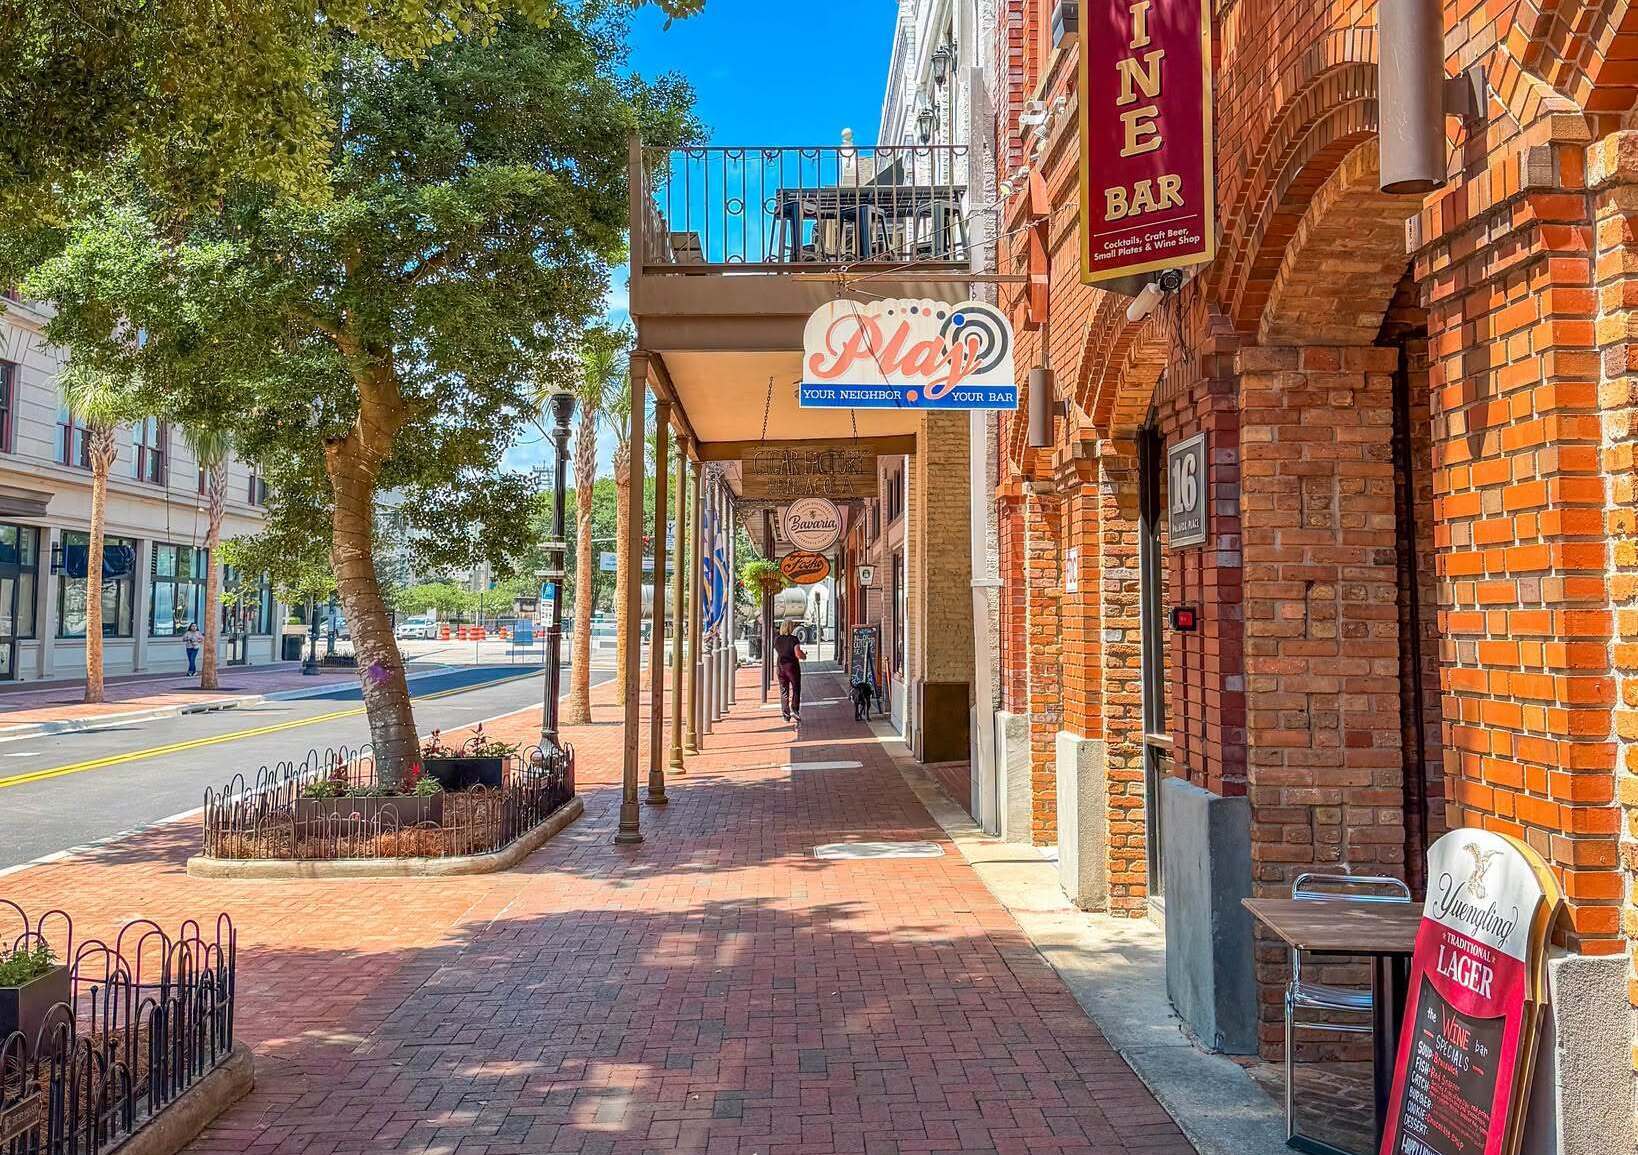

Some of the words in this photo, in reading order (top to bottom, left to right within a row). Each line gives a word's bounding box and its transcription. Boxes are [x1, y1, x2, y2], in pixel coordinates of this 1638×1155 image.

[1116, 0, 1165, 157] INE
[1104, 174, 1185, 221] BAR
[1094, 250, 1116, 261] Small
[1118, 246, 1142, 257] Plates
[1145, 242, 1152, 251] &
[1155, 240, 1176, 249] Wine
[1178, 234, 1200, 245] Shop
[1104, 236, 1143, 250] Cocktails,
[1145, 231, 1166, 242] Craft
[1168, 228, 1189, 238] Beer,
[808, 313, 983, 400] Play
[804, 389, 835, 400] YOUR
[841, 389, 901, 400] NEIGHBOR
[953, 393, 984, 402] YOUR
[989, 393, 1013, 402] BAR
[1172, 453, 1197, 514] 16
[788, 515, 837, 532] Bavaria
[1433, 873, 1519, 949] Yuengling
[1447, 931, 1491, 963] TRADITIONAL
[1436, 944, 1494, 999] LAGER
[1427, 1007, 1437, 1023] the
[1442, 1004, 1471, 1051] WINE
[1475, 1040, 1488, 1057] bar
[1436, 1035, 1469, 1072] SPECIALS
